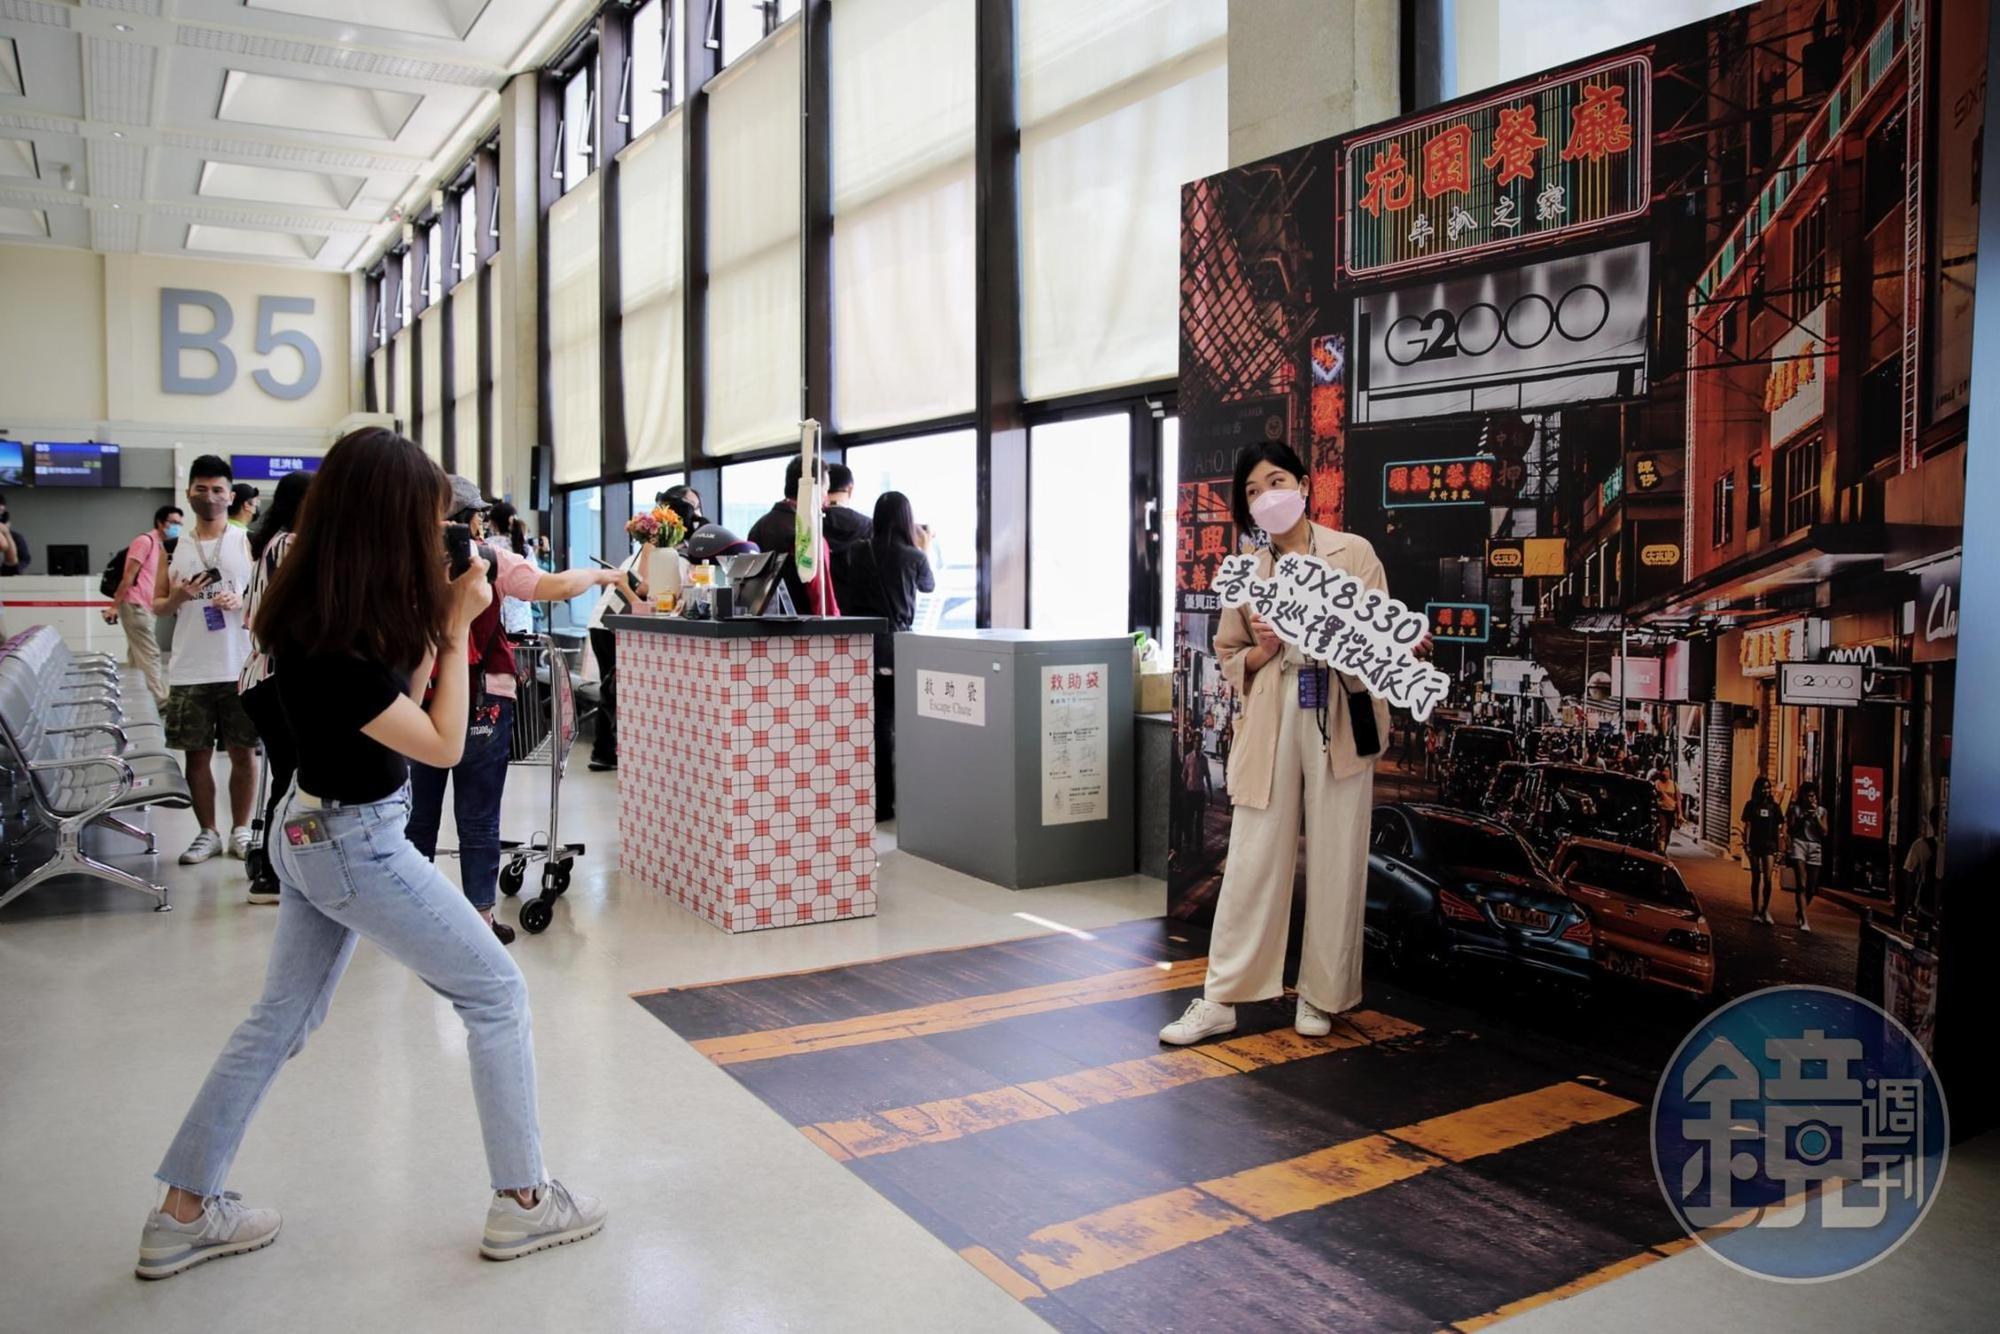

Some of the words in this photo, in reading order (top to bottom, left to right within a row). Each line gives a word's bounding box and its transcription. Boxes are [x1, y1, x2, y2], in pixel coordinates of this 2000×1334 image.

[1359, 85, 1632, 218] 花園餐廳
[1409, 183, 1566, 248] 牛扒之家
[161, 287, 322, 400] B5
[1385, 284, 1610, 367] G2000
[1279, 557, 1422, 645] #JX8330
[924, 677, 977, 702] 救助袋
[1050, 671, 1100, 691] 救助袋
[1857, 813, 1878, 827] SALE
